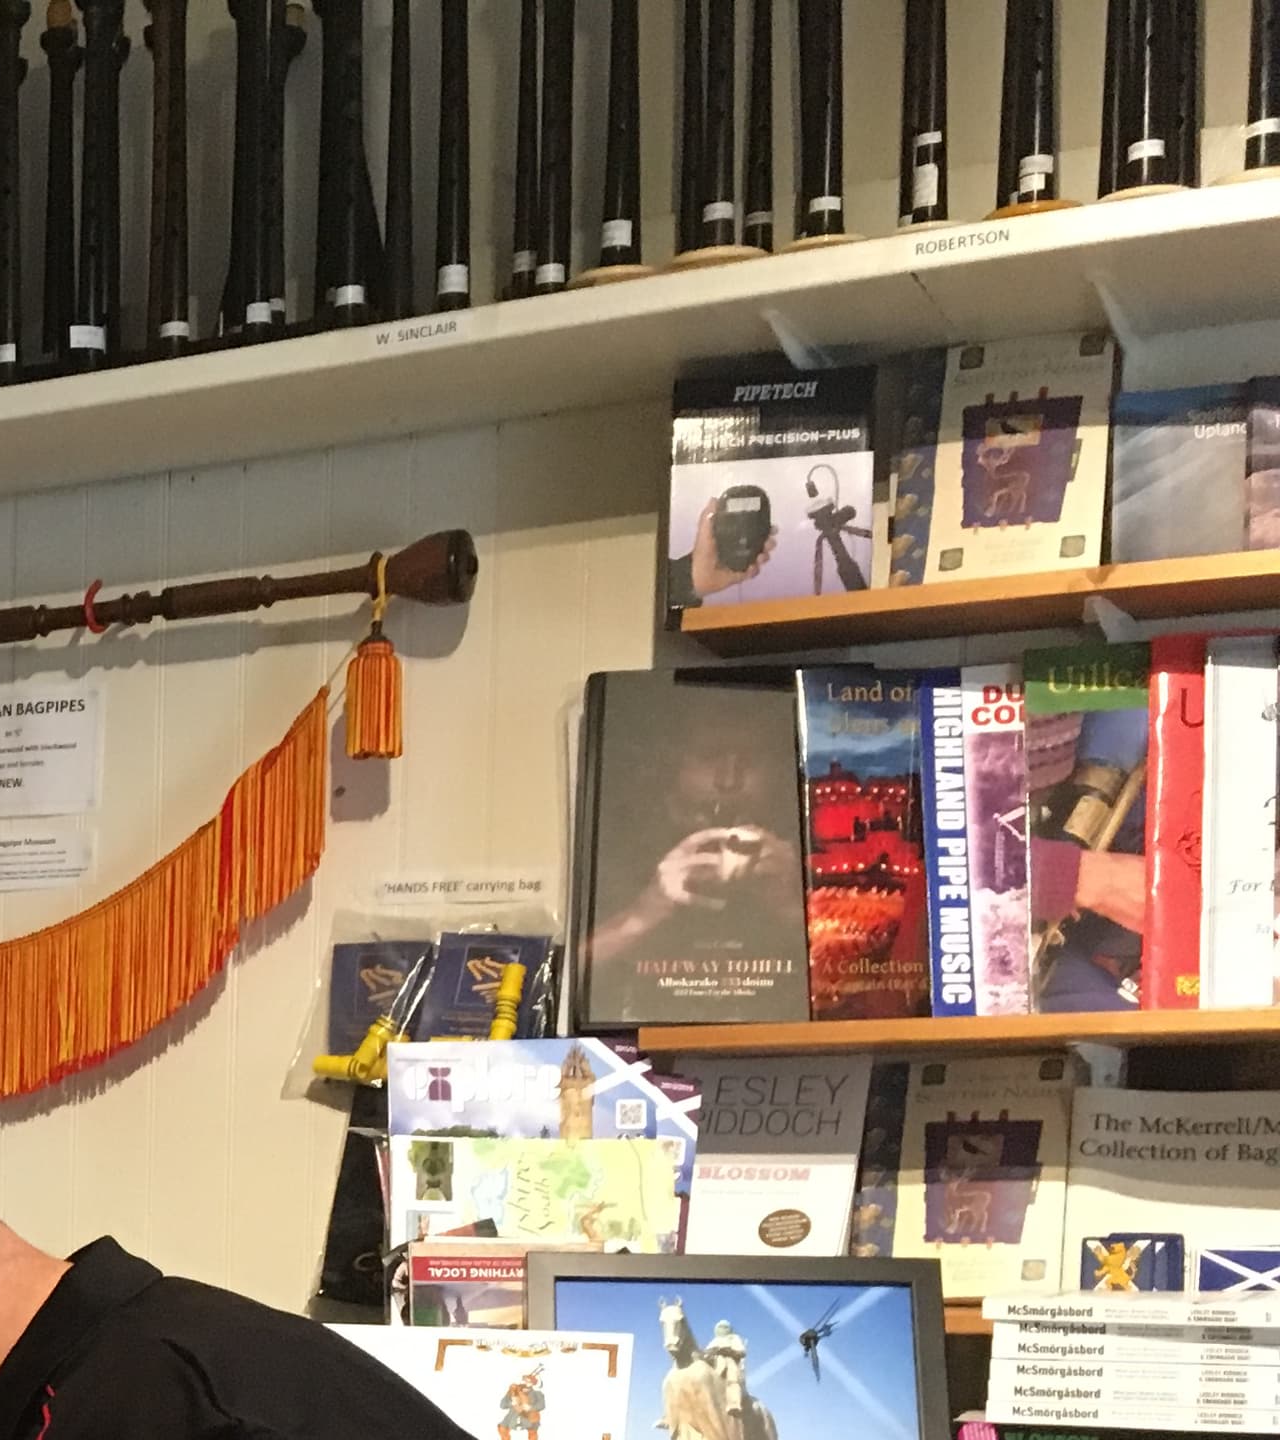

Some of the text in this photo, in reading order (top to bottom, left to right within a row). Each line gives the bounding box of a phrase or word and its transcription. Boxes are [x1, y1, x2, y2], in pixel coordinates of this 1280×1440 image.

[915, 229, 1010, 256] ROBERTSON
[397, 321, 458, 343] SINCLAIR
[733, 381, 818, 402] PIPETECH
[747, 427, 861, 446] PRECISION-PLUS
[827, 679, 883, 703] Land
[16, 698, 86, 716] BAGPIPES
[933, 687, 973, 1005] HIGHLAND PIPE MUSIC
[466, 879, 516, 894] carrying
[517, 877, 542, 891] bag
[726, 959, 749, 973] TO
[838, 956, 925, 975] Collection
[708, 1074, 850, 1106] ESLEY
[1090, 1113, 1132, 1132] The
[1079, 1138, 1198, 1162] Collection
[1204, 1143, 1231, 1161] of
[696, 1166, 812, 1182] BLOSSOM
[427, 1267, 467, 1279] LOCAL
